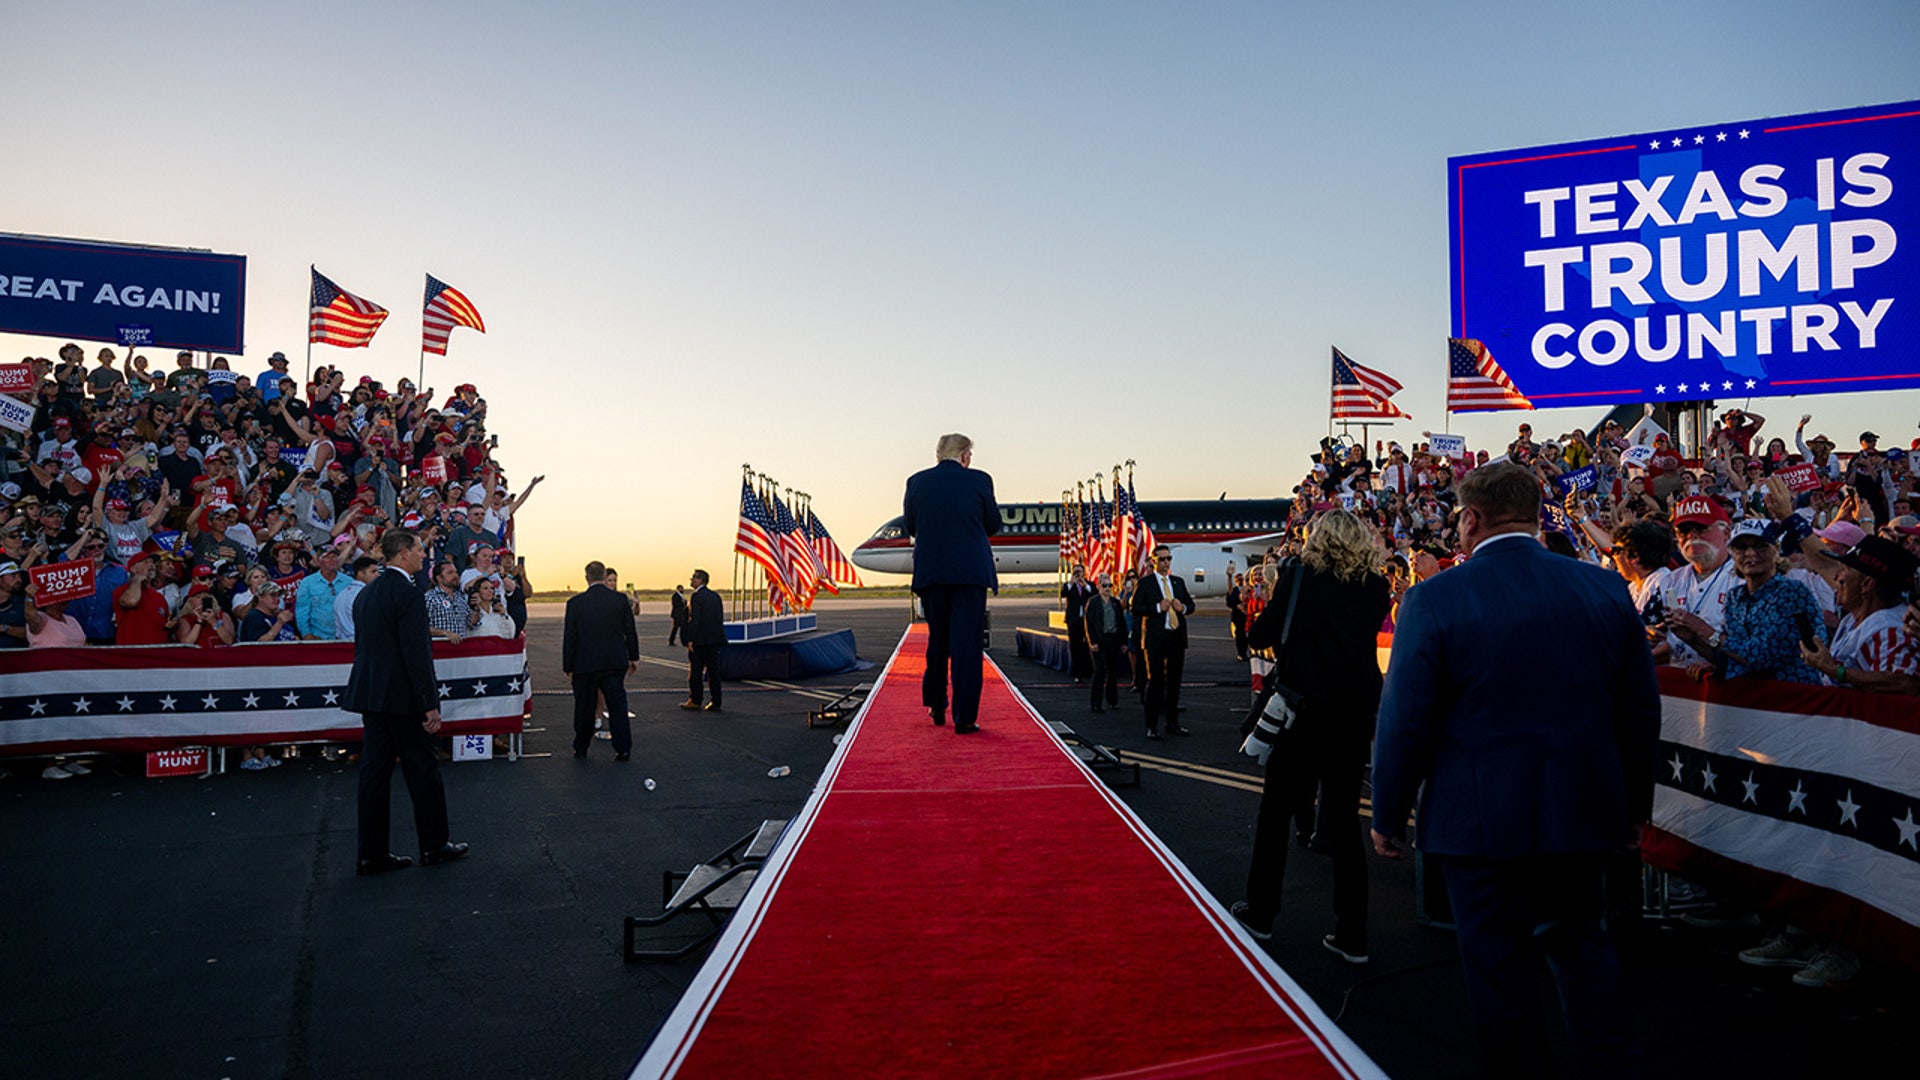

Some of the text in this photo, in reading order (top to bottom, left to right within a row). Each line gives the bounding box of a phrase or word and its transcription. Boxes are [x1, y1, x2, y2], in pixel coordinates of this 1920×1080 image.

[1524, 152, 1894, 239] TEXAS IS
[1524, 217, 1898, 313] TRUMP
[93, 282, 221, 315] AGAIN!
[118, 327, 152, 336] TRUMP
[1530, 298, 1895, 369] COUNTRY
[1, 408, 25, 424] 2024
[1433, 437, 1462, 445] TRUMP
[1562, 469, 1593, 487] TRUMP
[999, 507, 1062, 525] UM
[1675, 500, 1711, 518] MAGA
[1733, 520, 1765, 535] USA
[36, 565, 90, 584] TRUMP
[45, 576, 83, 593] 2024
[159, 755, 202, 769] HUNT
